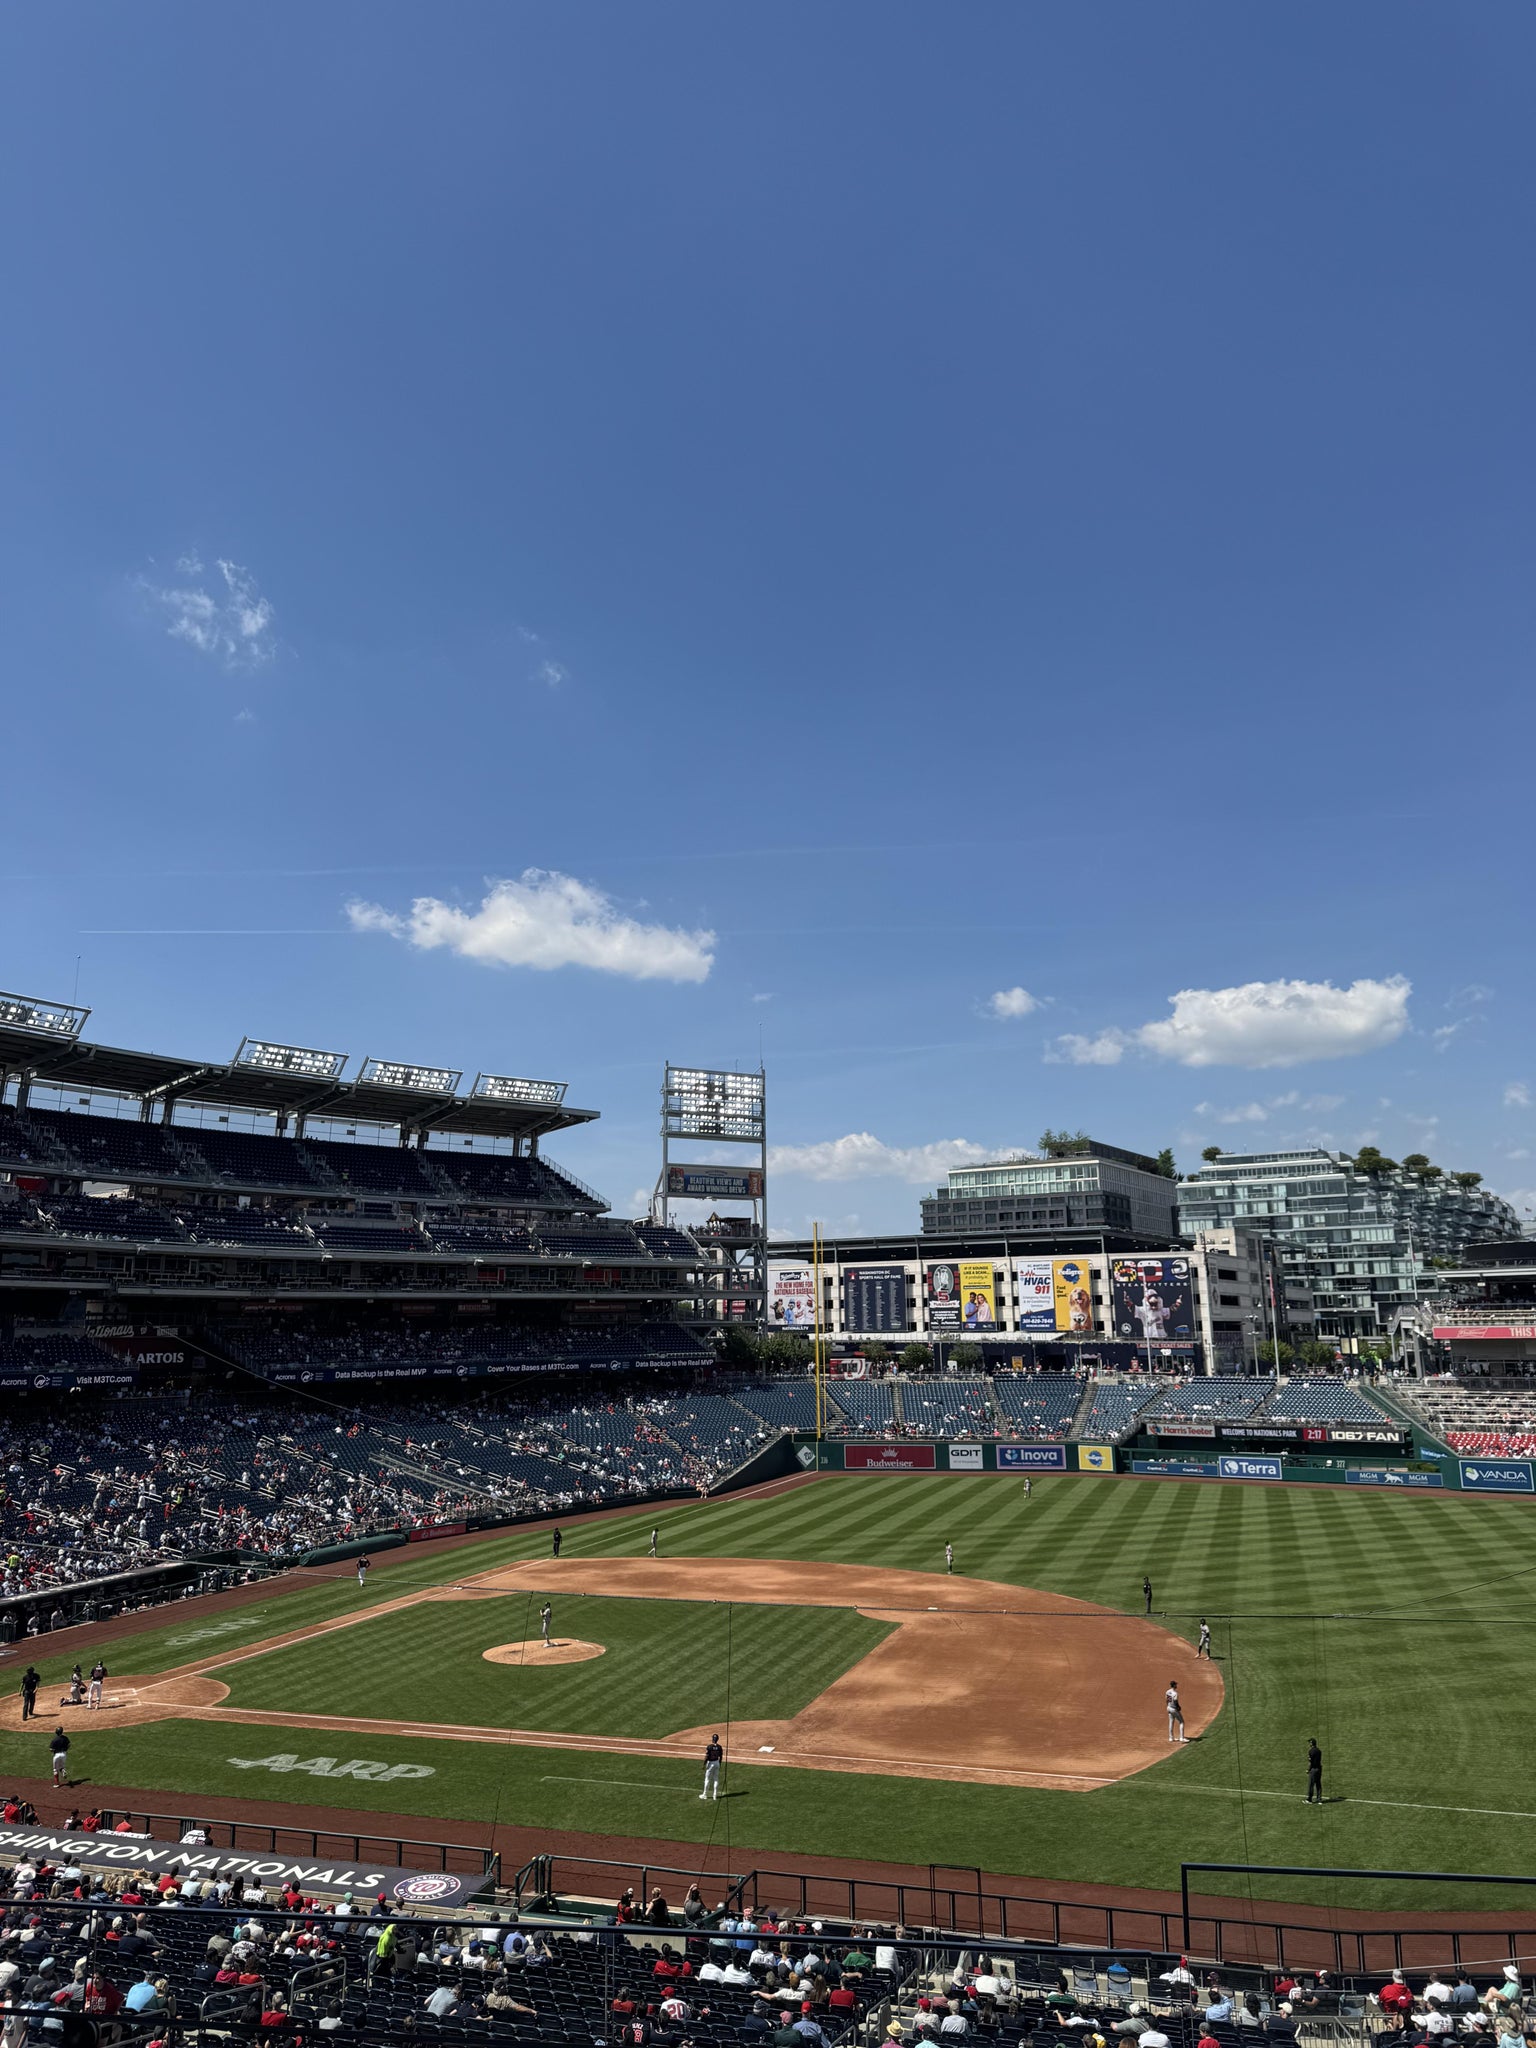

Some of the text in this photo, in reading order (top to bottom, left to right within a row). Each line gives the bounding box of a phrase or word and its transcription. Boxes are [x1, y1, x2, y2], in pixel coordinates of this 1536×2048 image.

[1024, 1277, 1051, 1285] HVAC
[1035, 1286, 1050, 1294] 911
[1510, 1327, 1532, 1337] THIS
[136, 1352, 184, 1364] ARTOIS
[506, 1364, 520, 1372] Your
[649, 1360, 671, 1368] Backup
[335, 1371, 350, 1379] Data
[351, 1370, 375, 1379] Backup
[411, 1368, 427, 1376] MVP
[1, 1375, 132, 1386] Acronis Visit M3TC.com
[1163, 1425, 1213, 1435] Harris Teeter
[1221, 1428, 1245, 1436] WELCOME
[1253, 1429, 1281, 1437] NATIONALS
[1308, 1430, 1321, 1439] 2:17
[1366, 1432, 1399, 1441] FAN
[1021, 1450, 1057, 1461] Inova
[867, 1459, 913, 1467] Budweiser
[1239, 1462, 1277, 1475] Terra
[1479, 1470, 1527, 1480] VANDA
[244, 1754, 436, 1781] AARP
[166, 1851, 386, 1888] NATIONALS
[634, 2029, 643, 2043] 8
